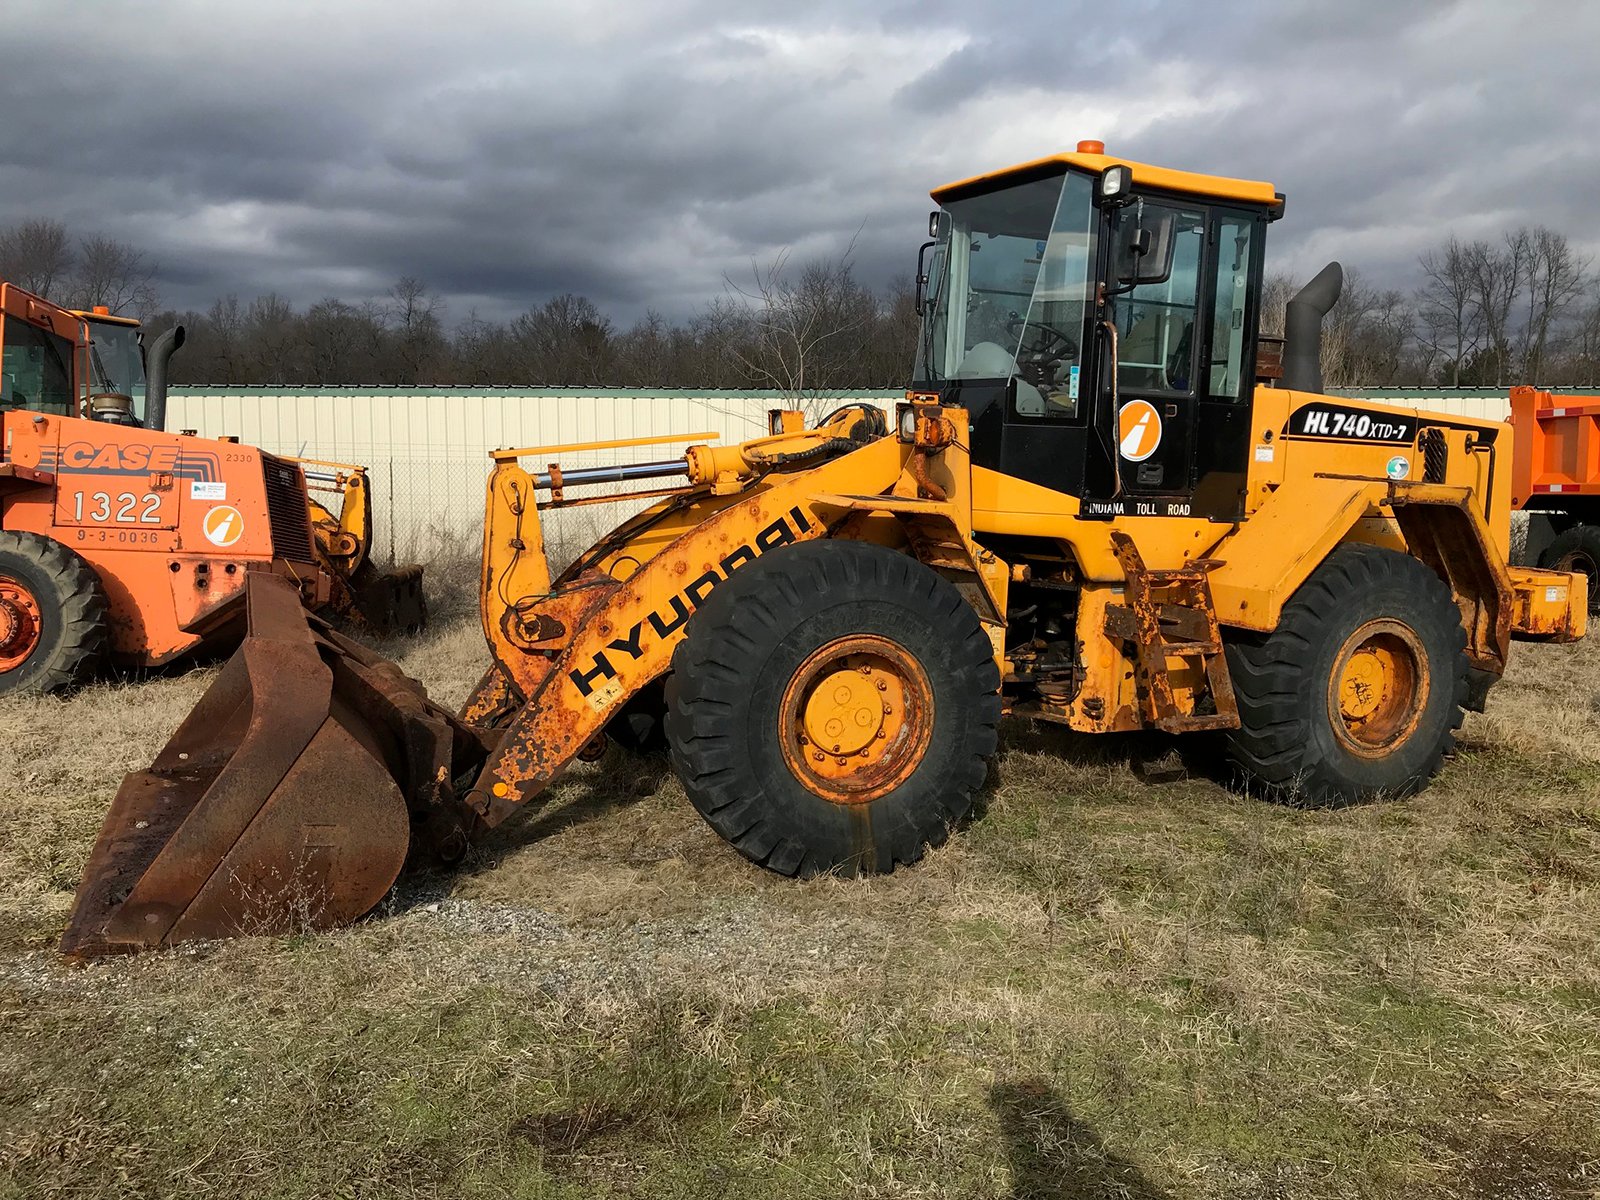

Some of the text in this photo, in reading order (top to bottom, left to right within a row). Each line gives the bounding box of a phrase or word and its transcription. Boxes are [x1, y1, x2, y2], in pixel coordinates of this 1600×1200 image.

[63, 442, 181, 470] CASE
[226, 453, 252, 463] 2330
[74, 491, 161, 523] 1322
[1089, 503, 1190, 515] INDIANA TOLL ROAD
[77, 530, 158, 543] 9-3-0036
